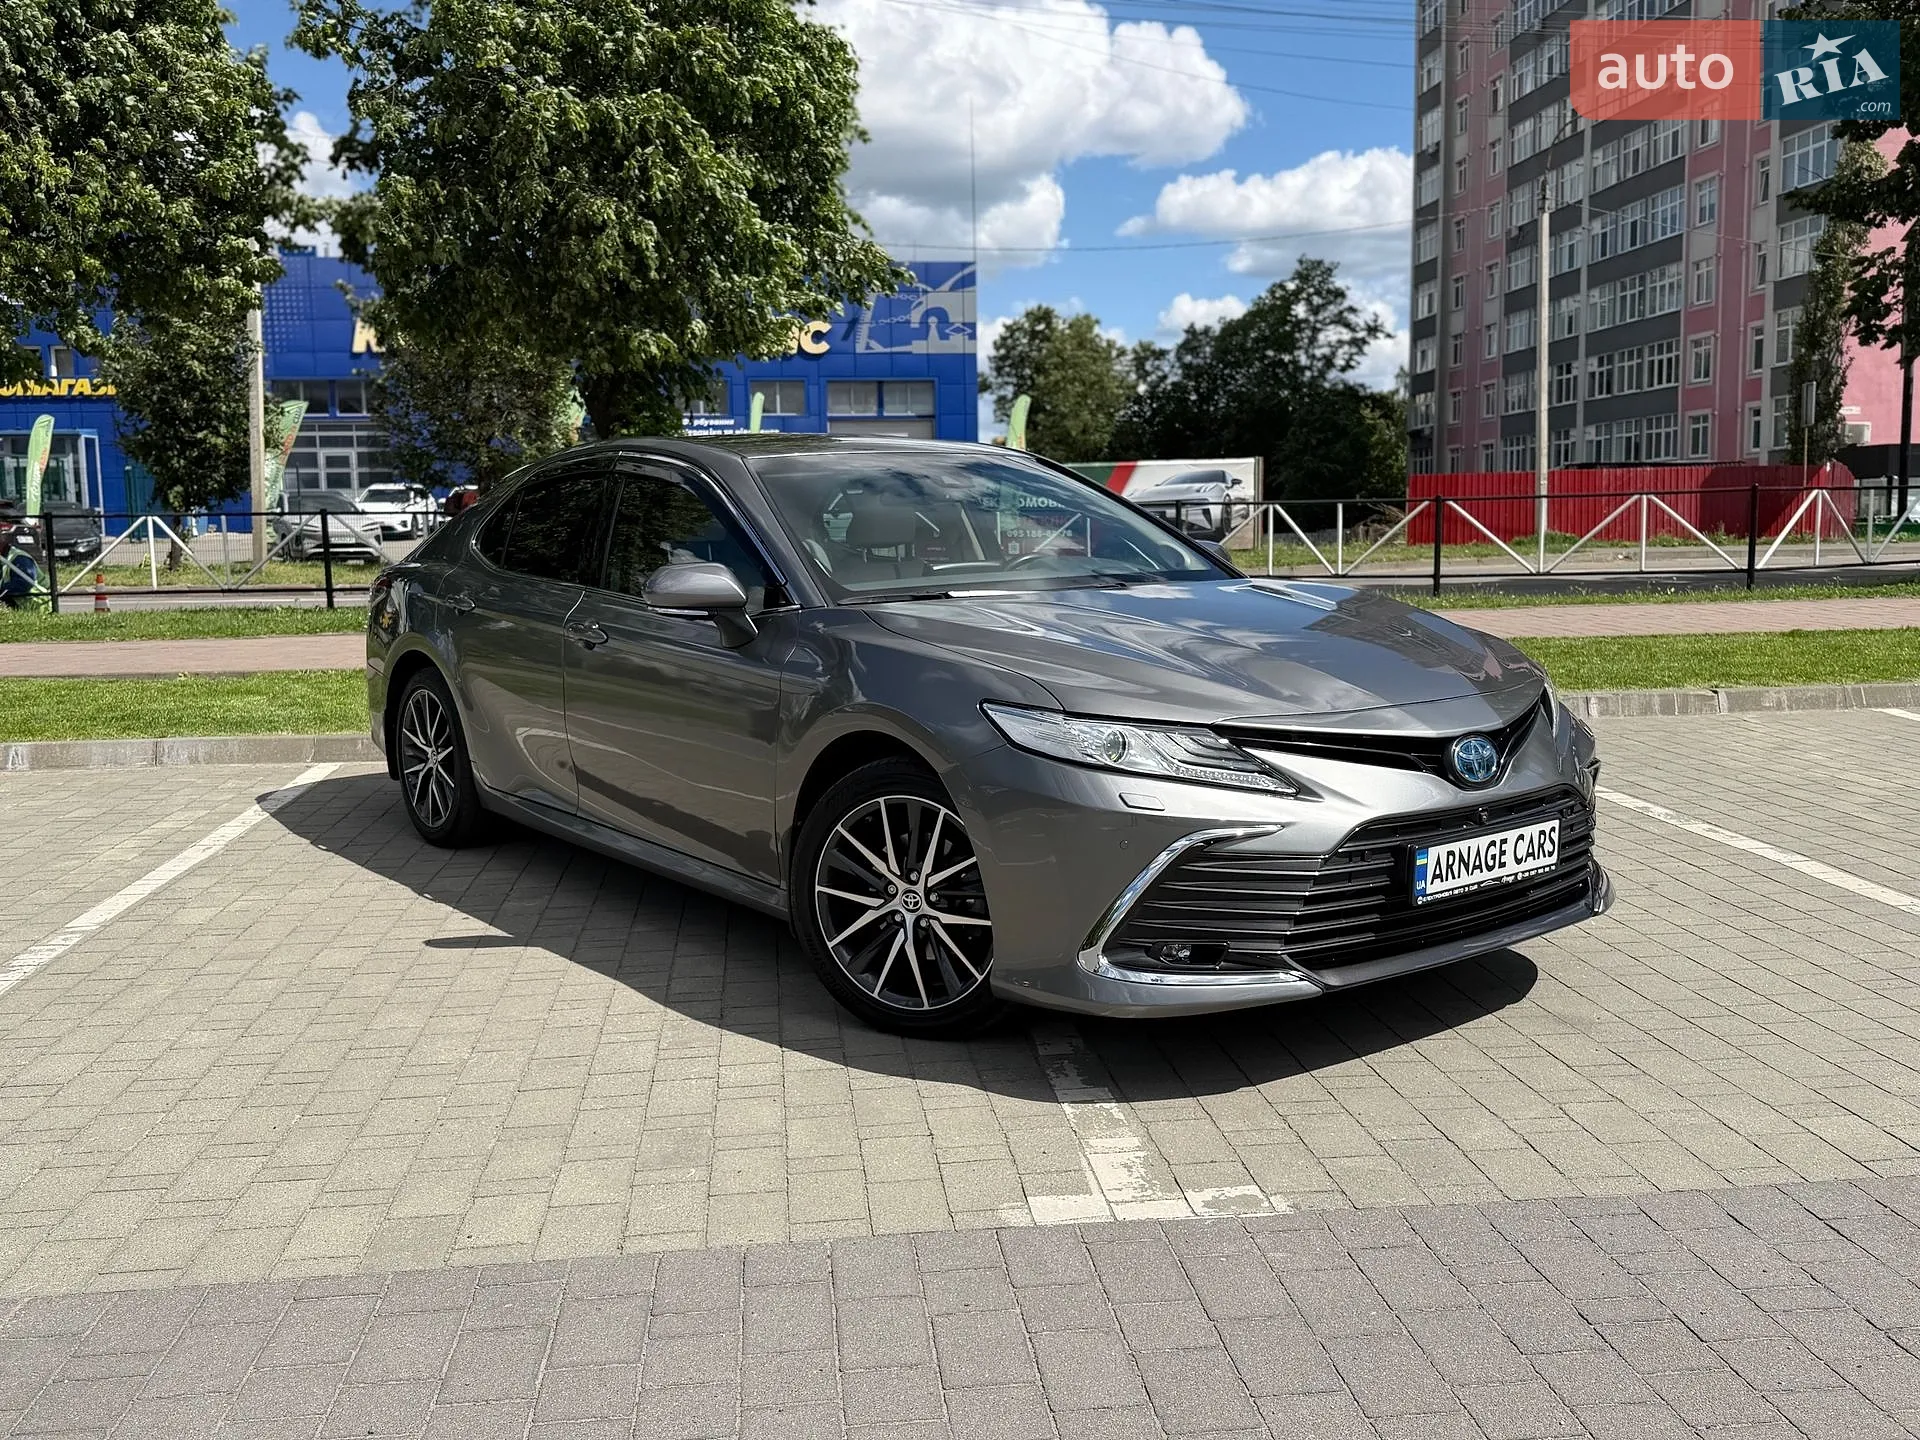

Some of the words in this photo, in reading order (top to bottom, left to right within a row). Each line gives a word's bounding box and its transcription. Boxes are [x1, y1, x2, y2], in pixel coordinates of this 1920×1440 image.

[1430, 838, 1508, 885] ARNAGE
[1513, 826, 1556, 865] CARS
[1416, 880, 1426, 890] UA
